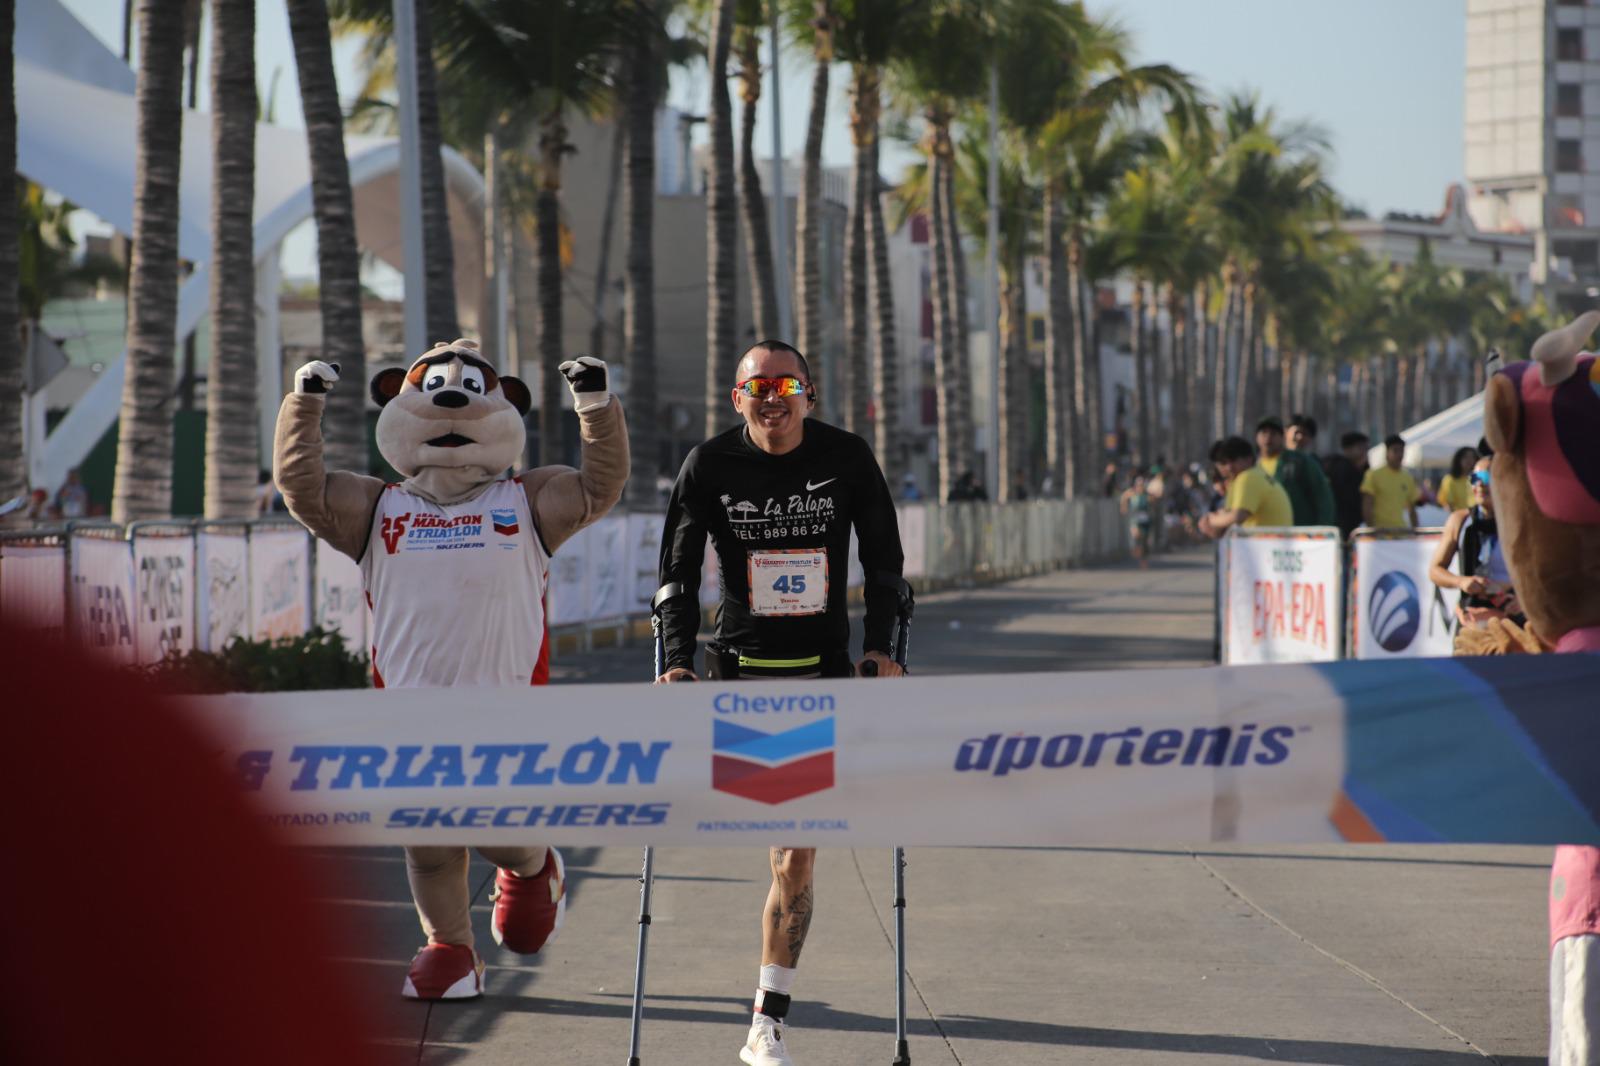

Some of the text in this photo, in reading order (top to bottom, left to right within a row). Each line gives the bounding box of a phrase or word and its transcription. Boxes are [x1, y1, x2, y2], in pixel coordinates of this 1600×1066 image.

[763, 494, 835, 517] La Palapa
[774, 513, 815, 521] RESTAURANT
[733, 523, 827, 540] TEL: 989 86 24
[436, 542, 486, 550] SKECHERS
[773, 575, 806, 594] 45
[712, 692, 836, 714] Chevron
[953, 723, 1295, 777] dportenis
[333, 811, 371, 825] POR
[385, 802, 673, 829] SKECHERS
[696, 819, 849, 833] PATROCINADOR OFICIAL
